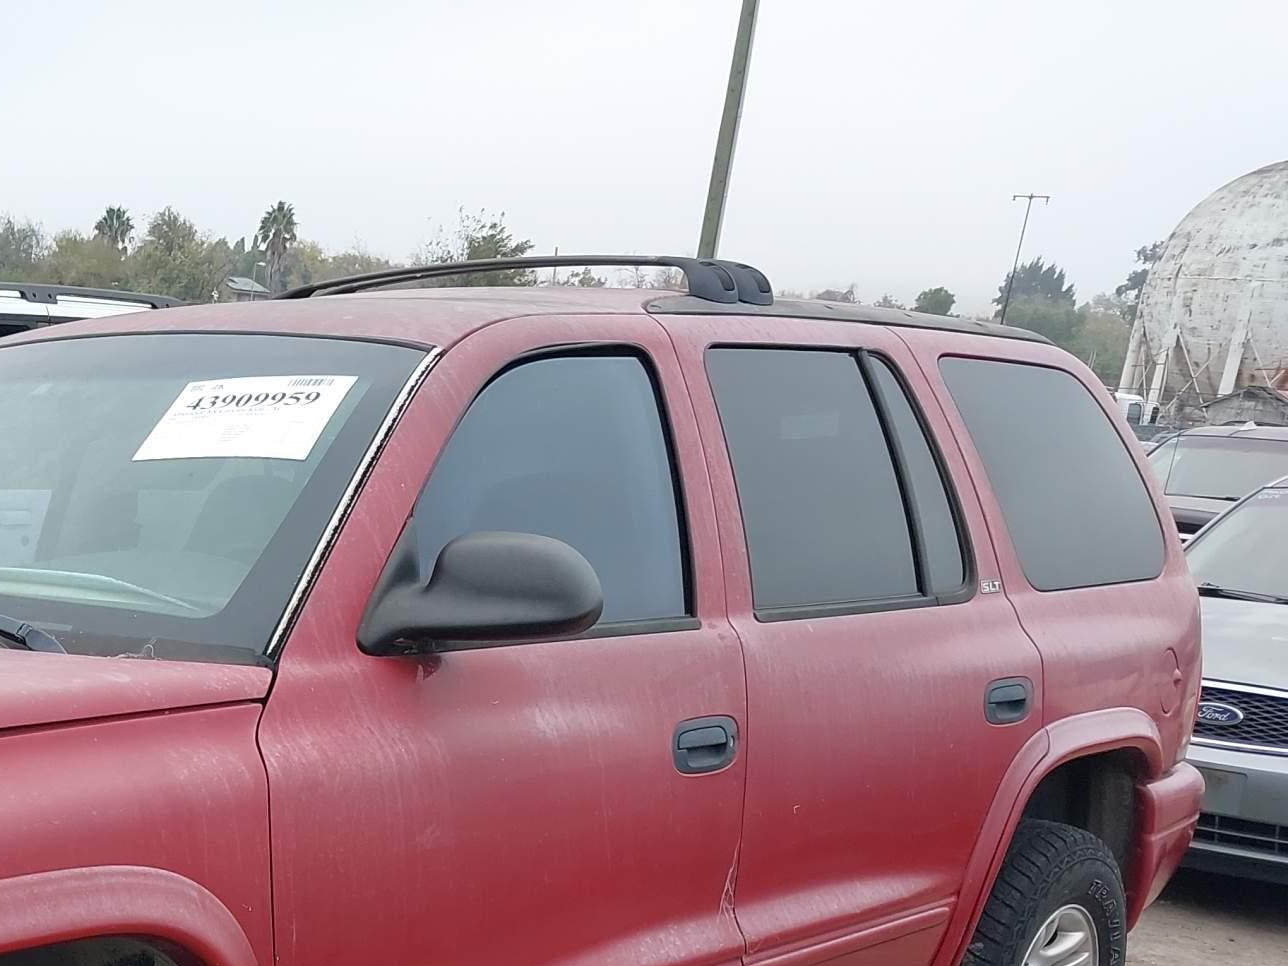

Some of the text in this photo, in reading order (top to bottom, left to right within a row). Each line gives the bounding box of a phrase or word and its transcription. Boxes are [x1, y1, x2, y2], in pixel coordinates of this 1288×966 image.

[186, 391, 321, 411] 43909959
[982, 581, 1000, 592] SLT
[1198, 706, 1231, 721] Ford
